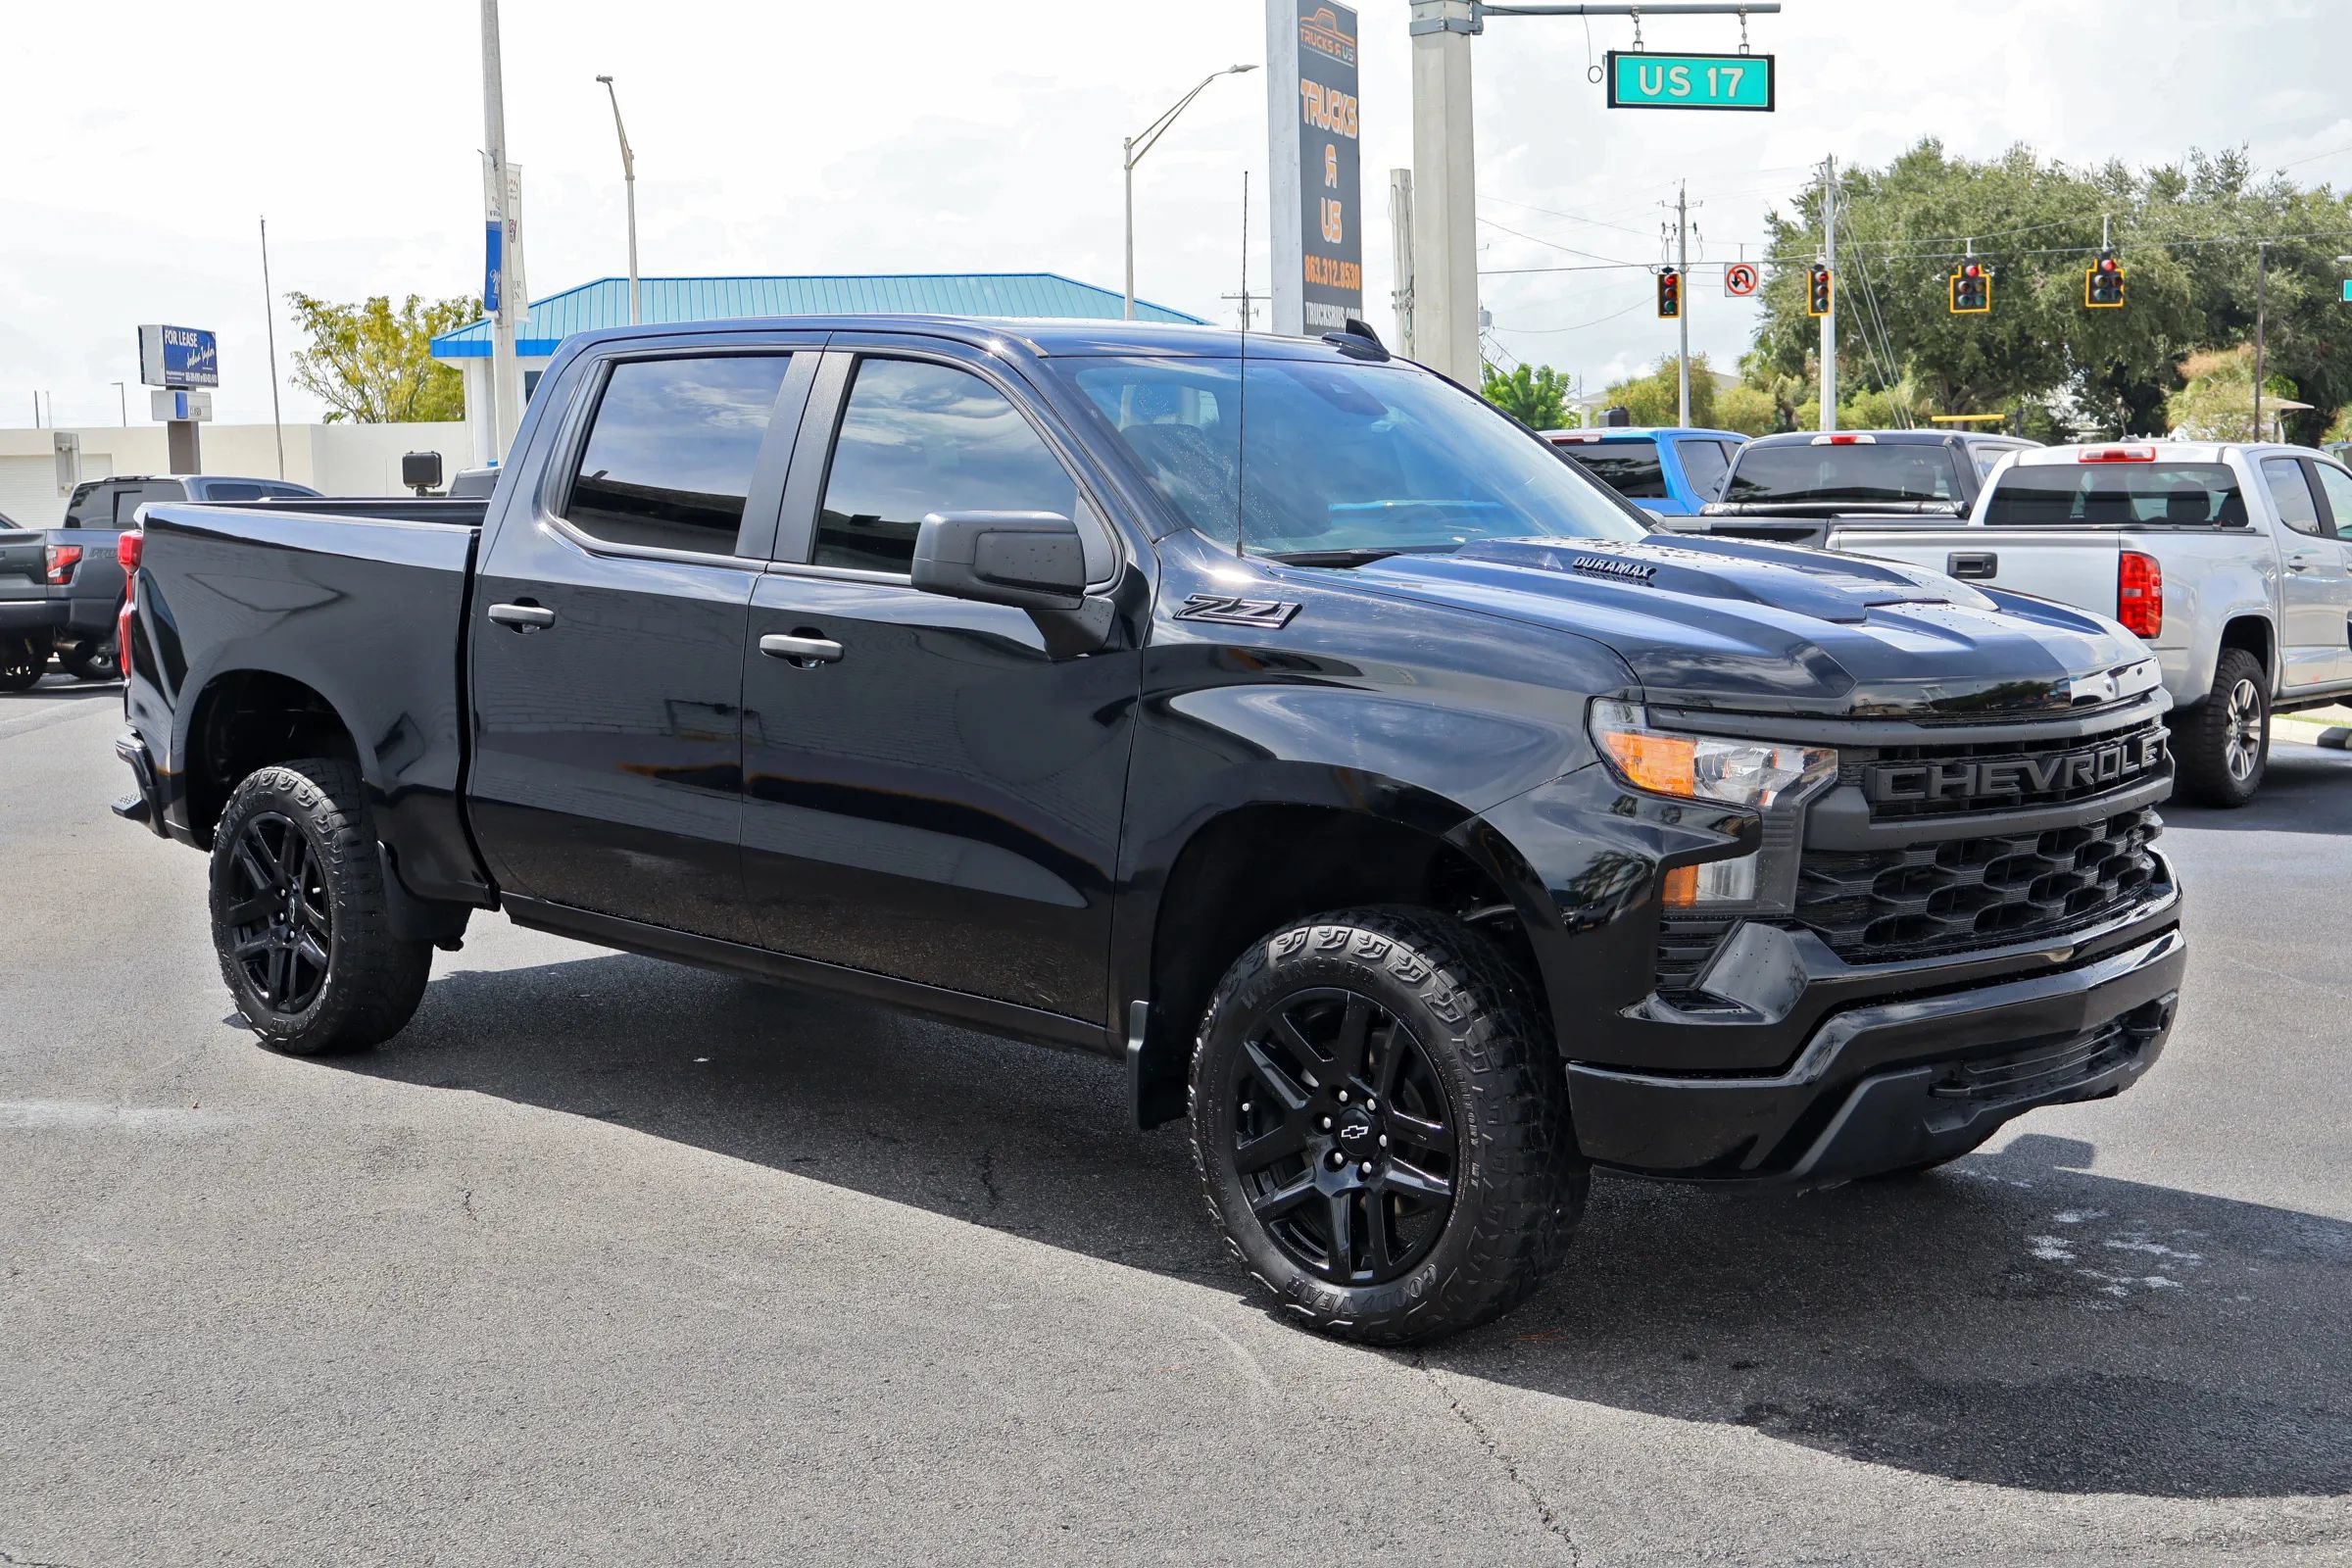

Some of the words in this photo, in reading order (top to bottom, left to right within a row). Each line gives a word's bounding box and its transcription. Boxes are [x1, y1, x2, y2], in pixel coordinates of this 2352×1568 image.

[1300, 27, 1333, 54] TRUCKS
[1342, 45, 1354, 62] US
[1639, 65, 1692, 97] US
[1706, 67, 1745, 98] 17
[1299, 77, 1358, 139] TRUCKS
[1320, 196, 1343, 244] US
[1304, 254, 1360, 291] 863.312.8530
[165, 329, 177, 345] FOR
[178, 331, 198, 348] LEASE
[1571, 556, 1656, 580] DURAMAX
[1173, 592, 1302, 630] Z71
[1868, 726, 2172, 803] CHEVROLET
